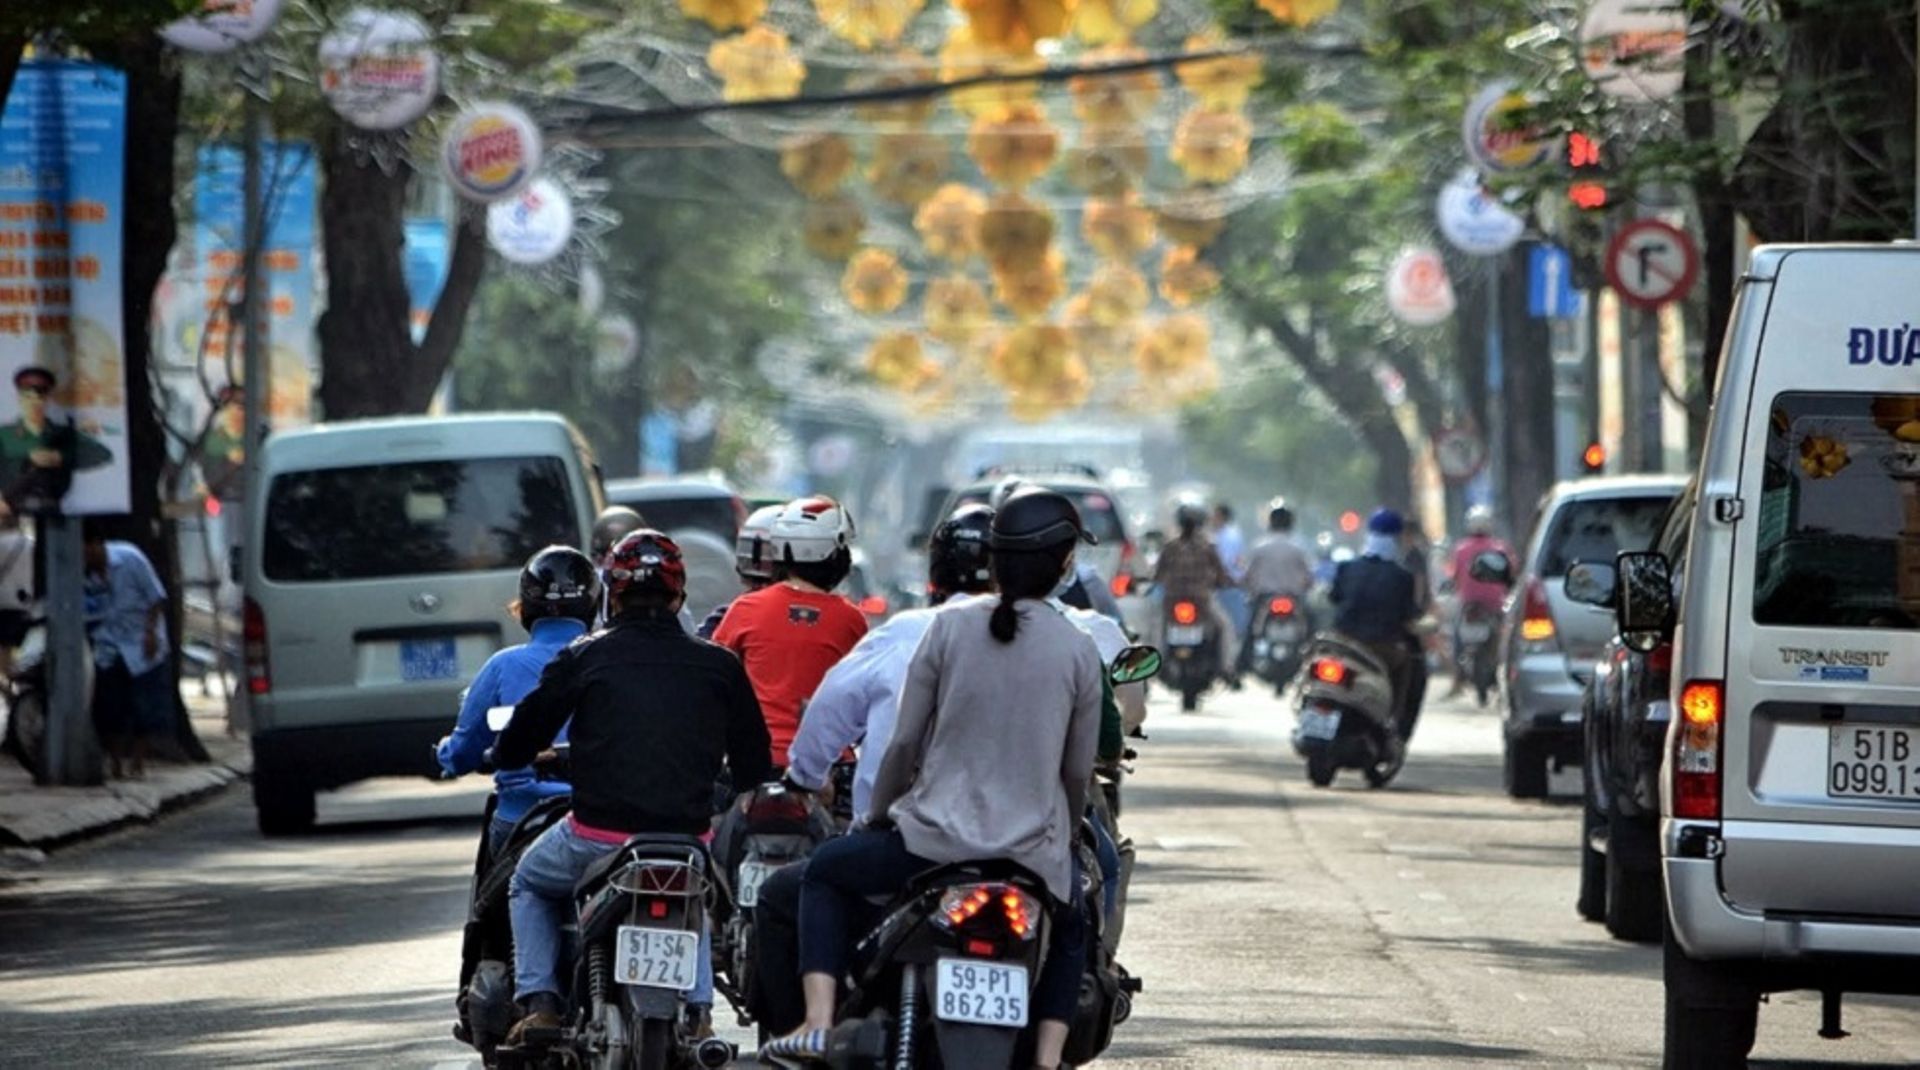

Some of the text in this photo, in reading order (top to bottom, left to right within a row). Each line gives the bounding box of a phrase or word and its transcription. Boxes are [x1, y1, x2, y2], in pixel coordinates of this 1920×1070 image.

[1779, 648, 1889, 667] TRANSIT
[1855, 730, 1909, 761] 51B
[629, 931, 686, 958] 51-S4
[628, 957, 684, 984] 8724
[952, 965, 1010, 994] 59-P1
[943, 991, 1021, 1021] 862.35
